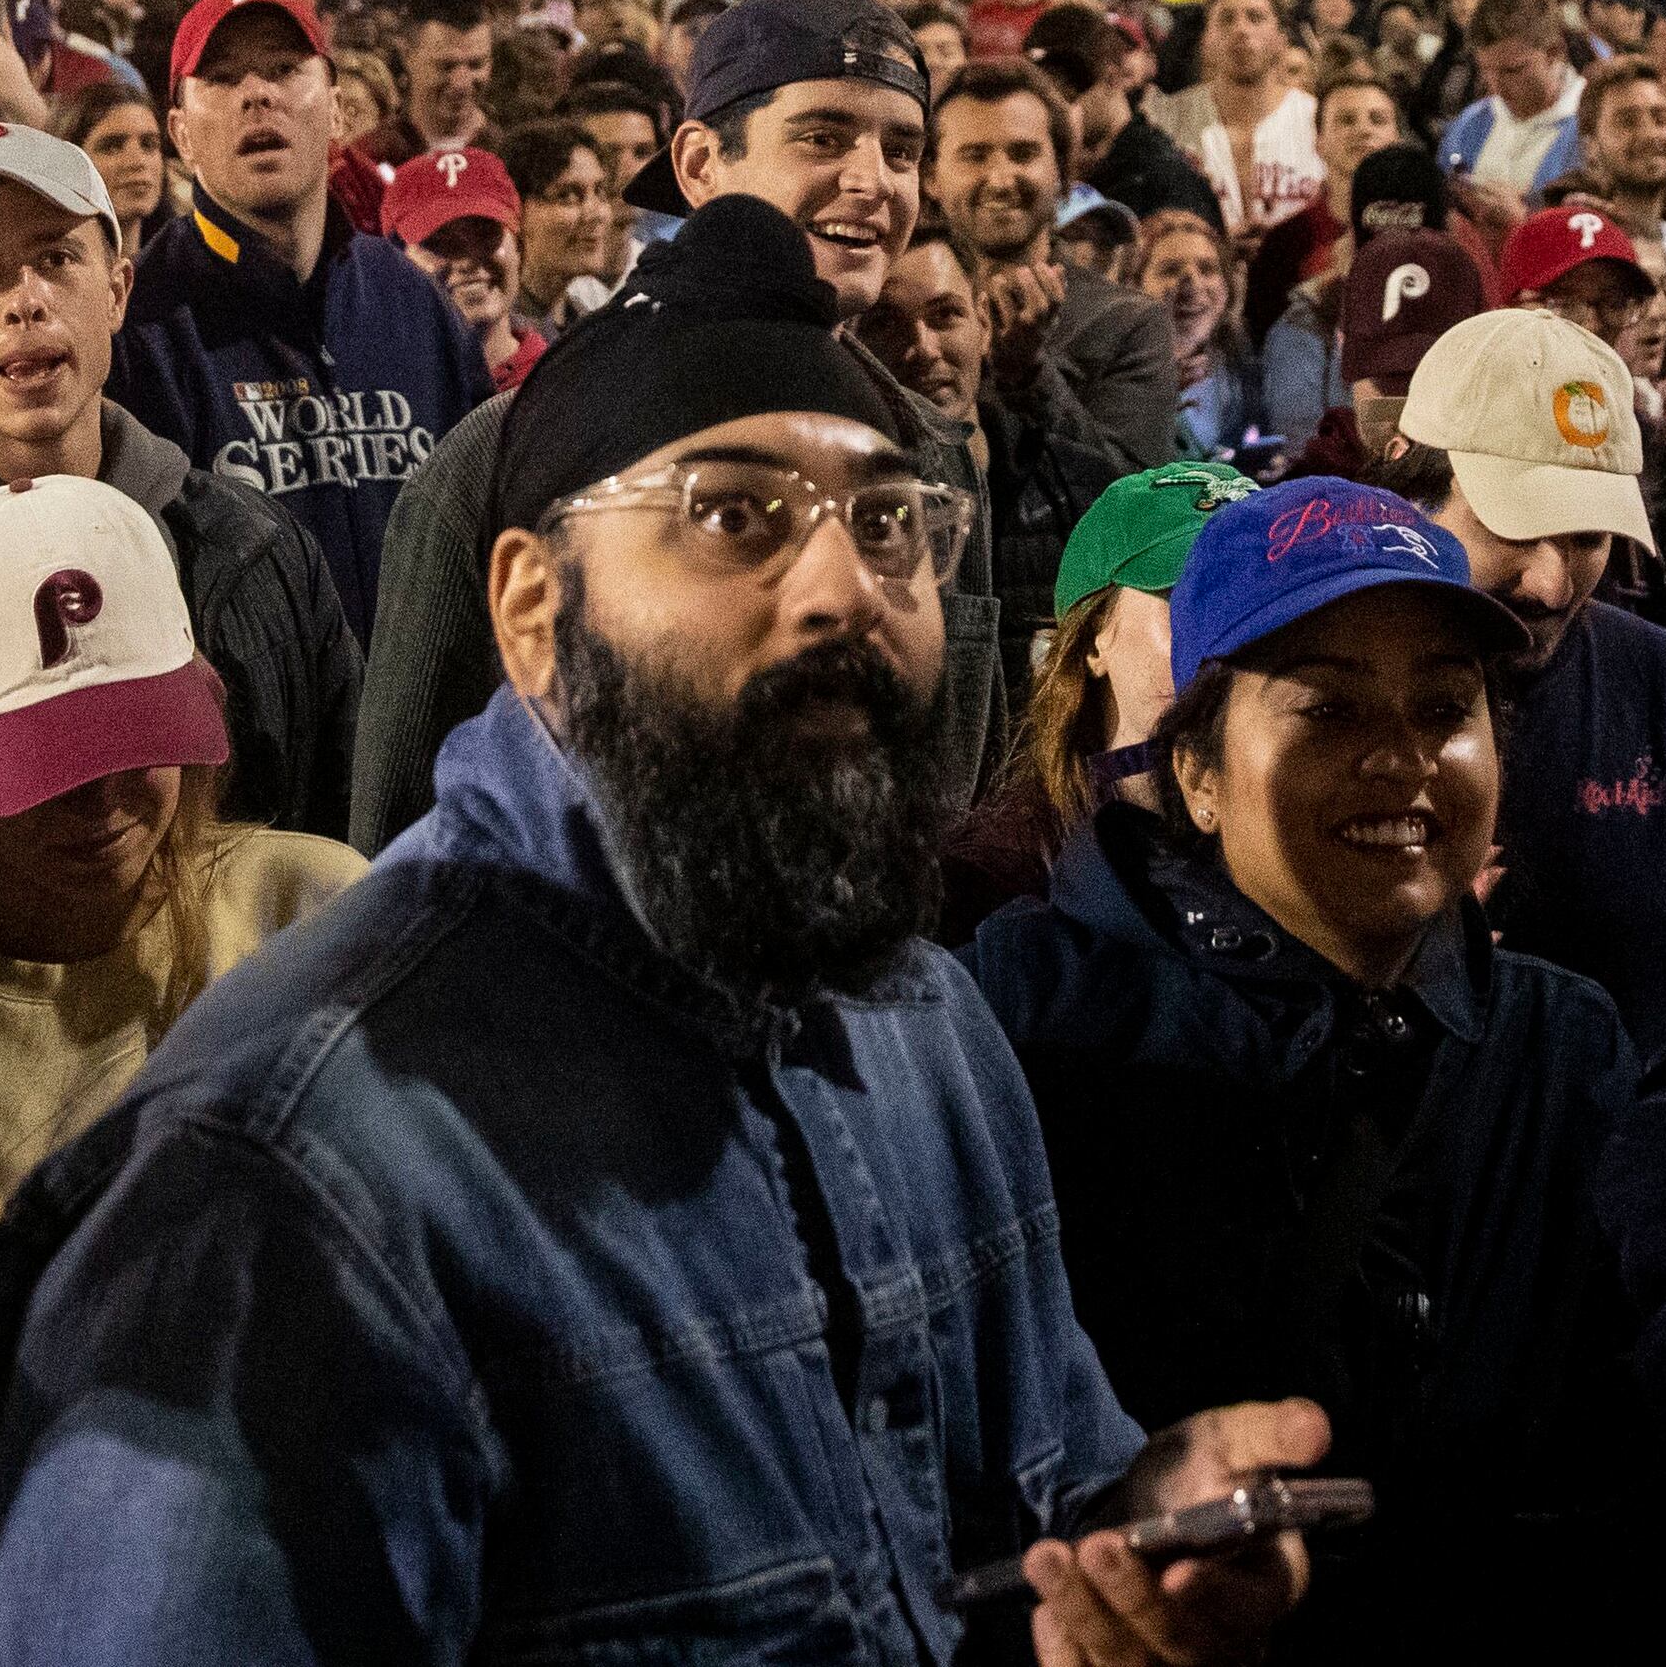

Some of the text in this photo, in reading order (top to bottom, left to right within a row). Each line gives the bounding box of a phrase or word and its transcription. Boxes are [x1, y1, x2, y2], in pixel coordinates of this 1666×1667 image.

[436, 152, 469, 189] P
[1566, 212, 1605, 249] P
[1381, 262, 1431, 322] P
[237, 387, 413, 443] WORLD
[32, 568, 104, 670] P
